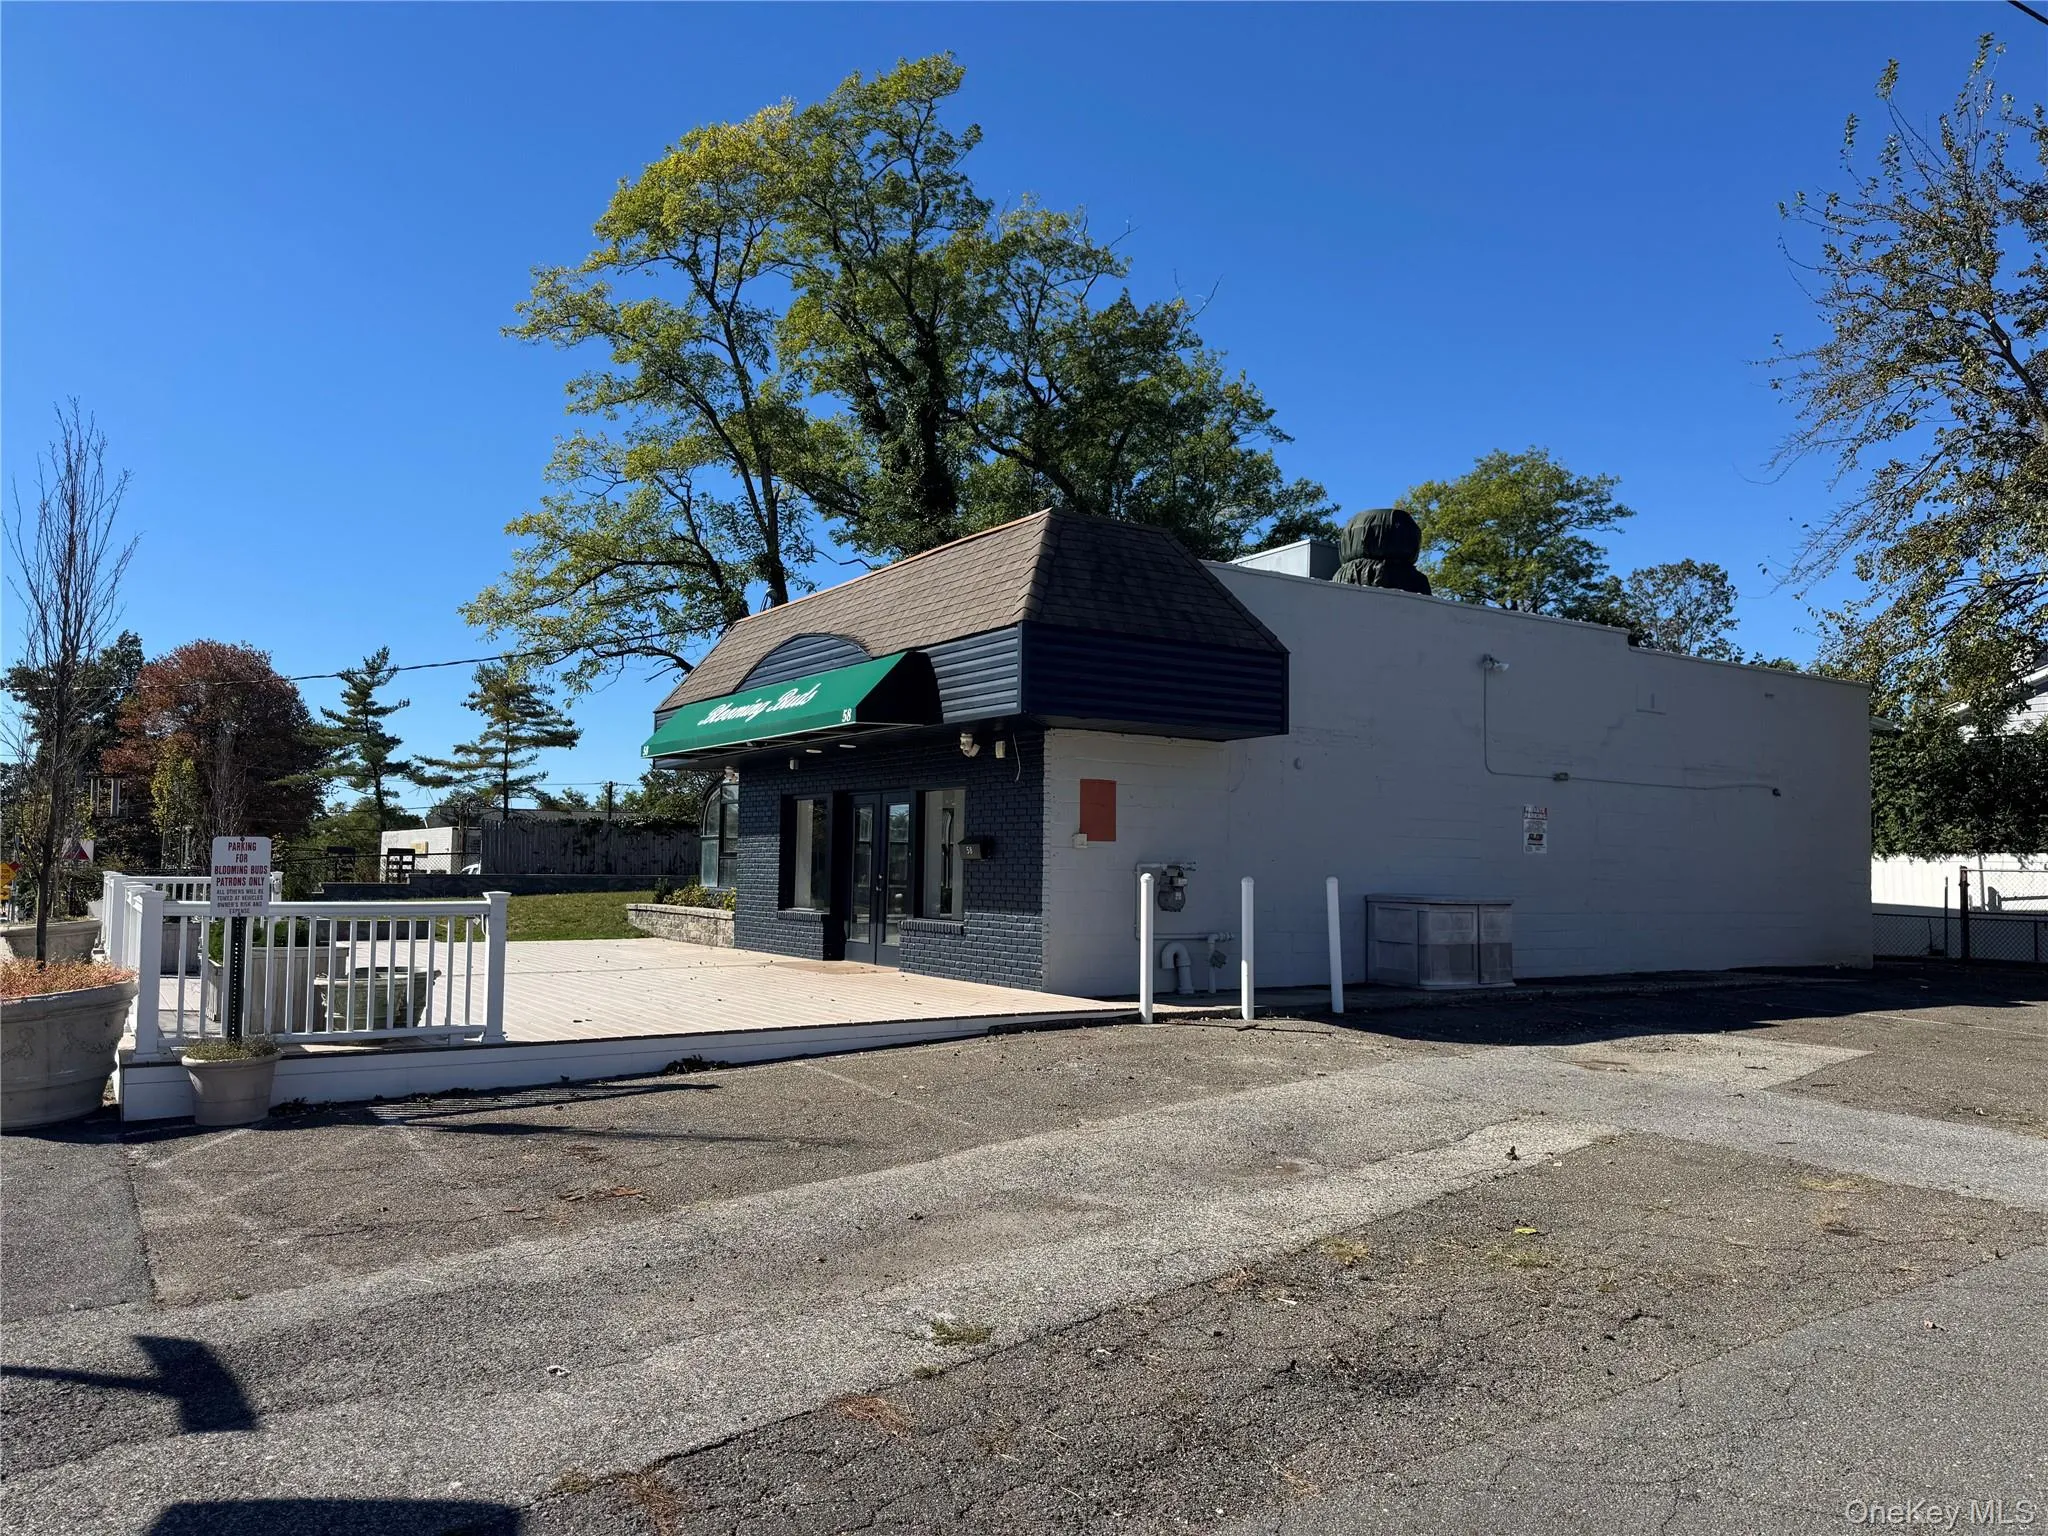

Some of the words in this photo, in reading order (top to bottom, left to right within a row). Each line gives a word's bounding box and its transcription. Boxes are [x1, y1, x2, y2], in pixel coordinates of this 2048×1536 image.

[841, 708, 852, 723] 58
[228, 842, 257, 851] PARKING
[236, 854, 248, 863] FOR
[215, 865, 248, 875] BLOOMING
[250, 865, 268, 875] BUDS
[216, 877, 247, 887] PATRONS
[249, 877, 265, 886] ONLY
